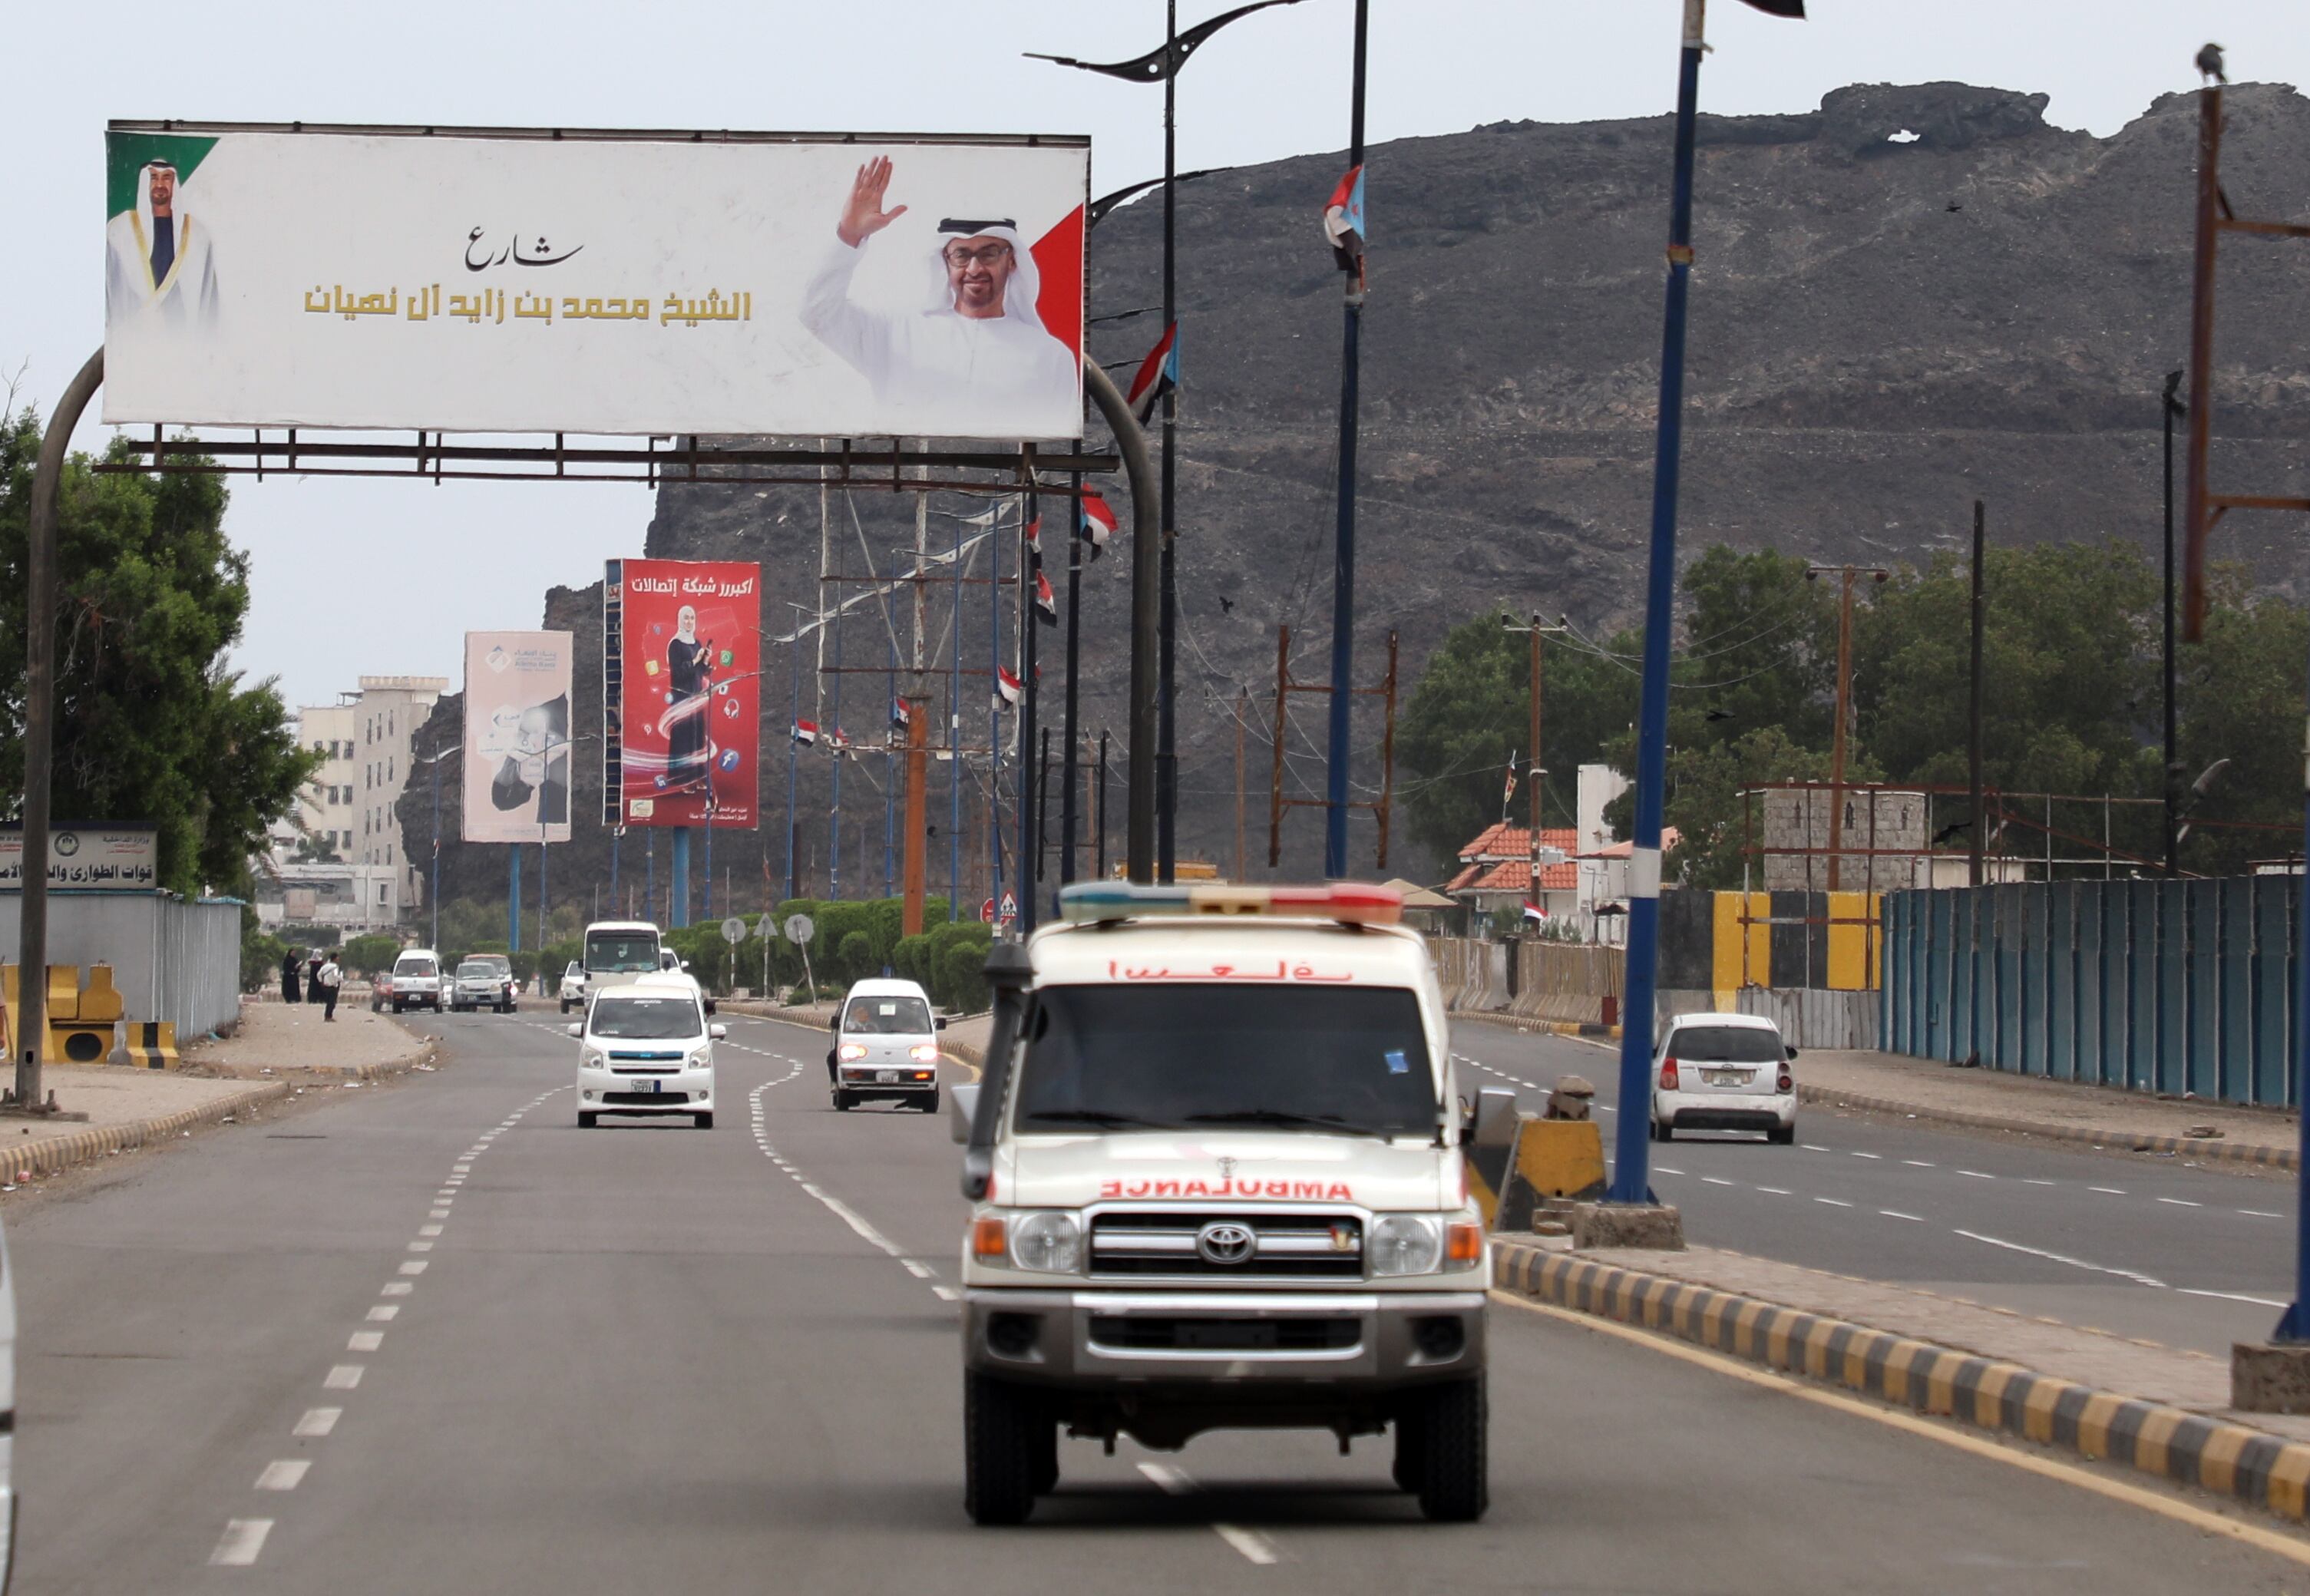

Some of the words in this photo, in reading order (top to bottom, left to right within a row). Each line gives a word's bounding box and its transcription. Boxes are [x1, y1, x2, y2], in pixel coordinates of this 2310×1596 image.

[464, 226, 583, 272] شارع
[305, 284, 397, 320] نهيان
[407, 283, 440, 320] آل
[449, 289, 504, 324] زايد
[514, 290, 551, 325] بن
[563, 296, 649, 319] محمد
[659, 288, 750, 327] الشيخ
[632, 578, 677, 596] إتصالات
[682, 577, 715, 596] شبكة
[103, 835, 133, 844] الداخلية
[134, 836, 150, 844] وزارة
[0, 861, 23, 880] الأم
[70, 864, 118, 883] الطوارئ
[121, 864, 153, 883] قوات
